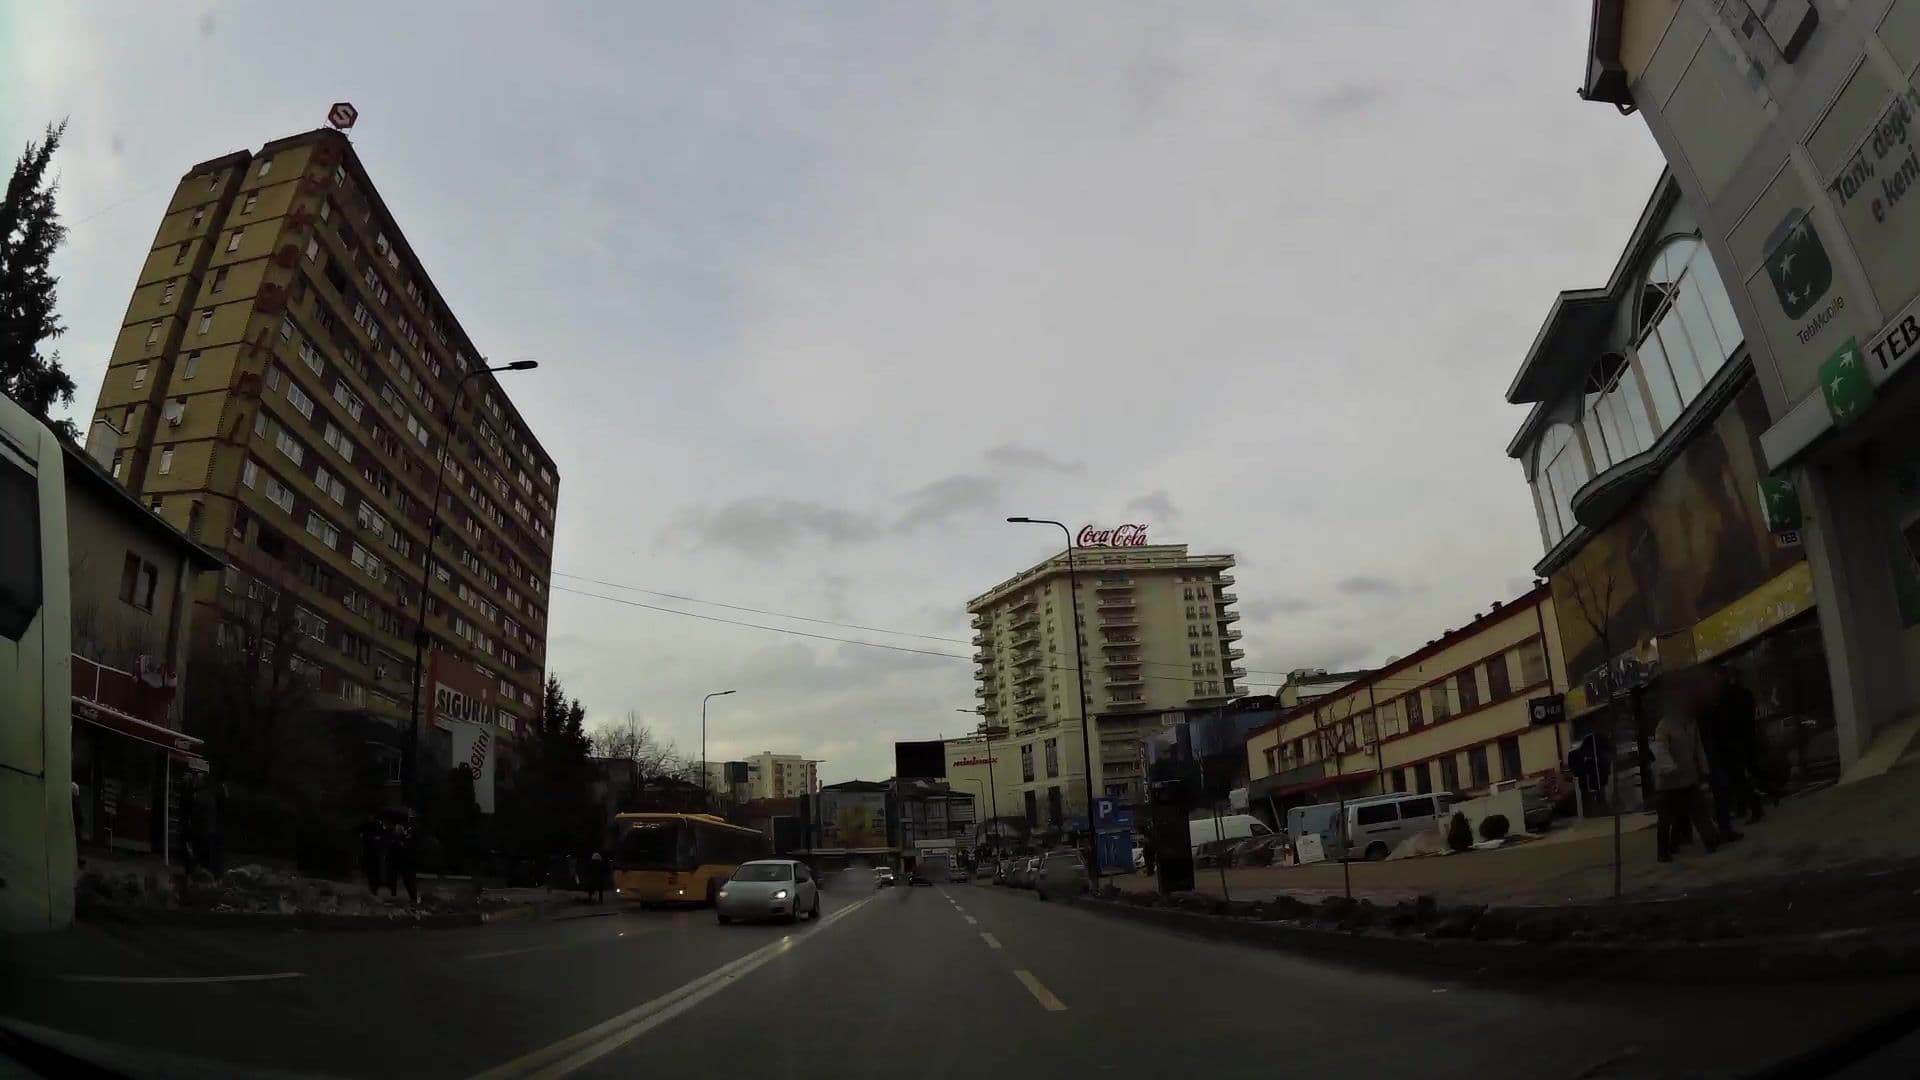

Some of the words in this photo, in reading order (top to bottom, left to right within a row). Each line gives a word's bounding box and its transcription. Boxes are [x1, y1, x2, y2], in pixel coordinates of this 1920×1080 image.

[1871, 197, 1885, 225] e
[1871, 316, 1920, 370] TEB
[1780, 532, 1798, 544] TEB
[1098, 800, 1113, 819] P
